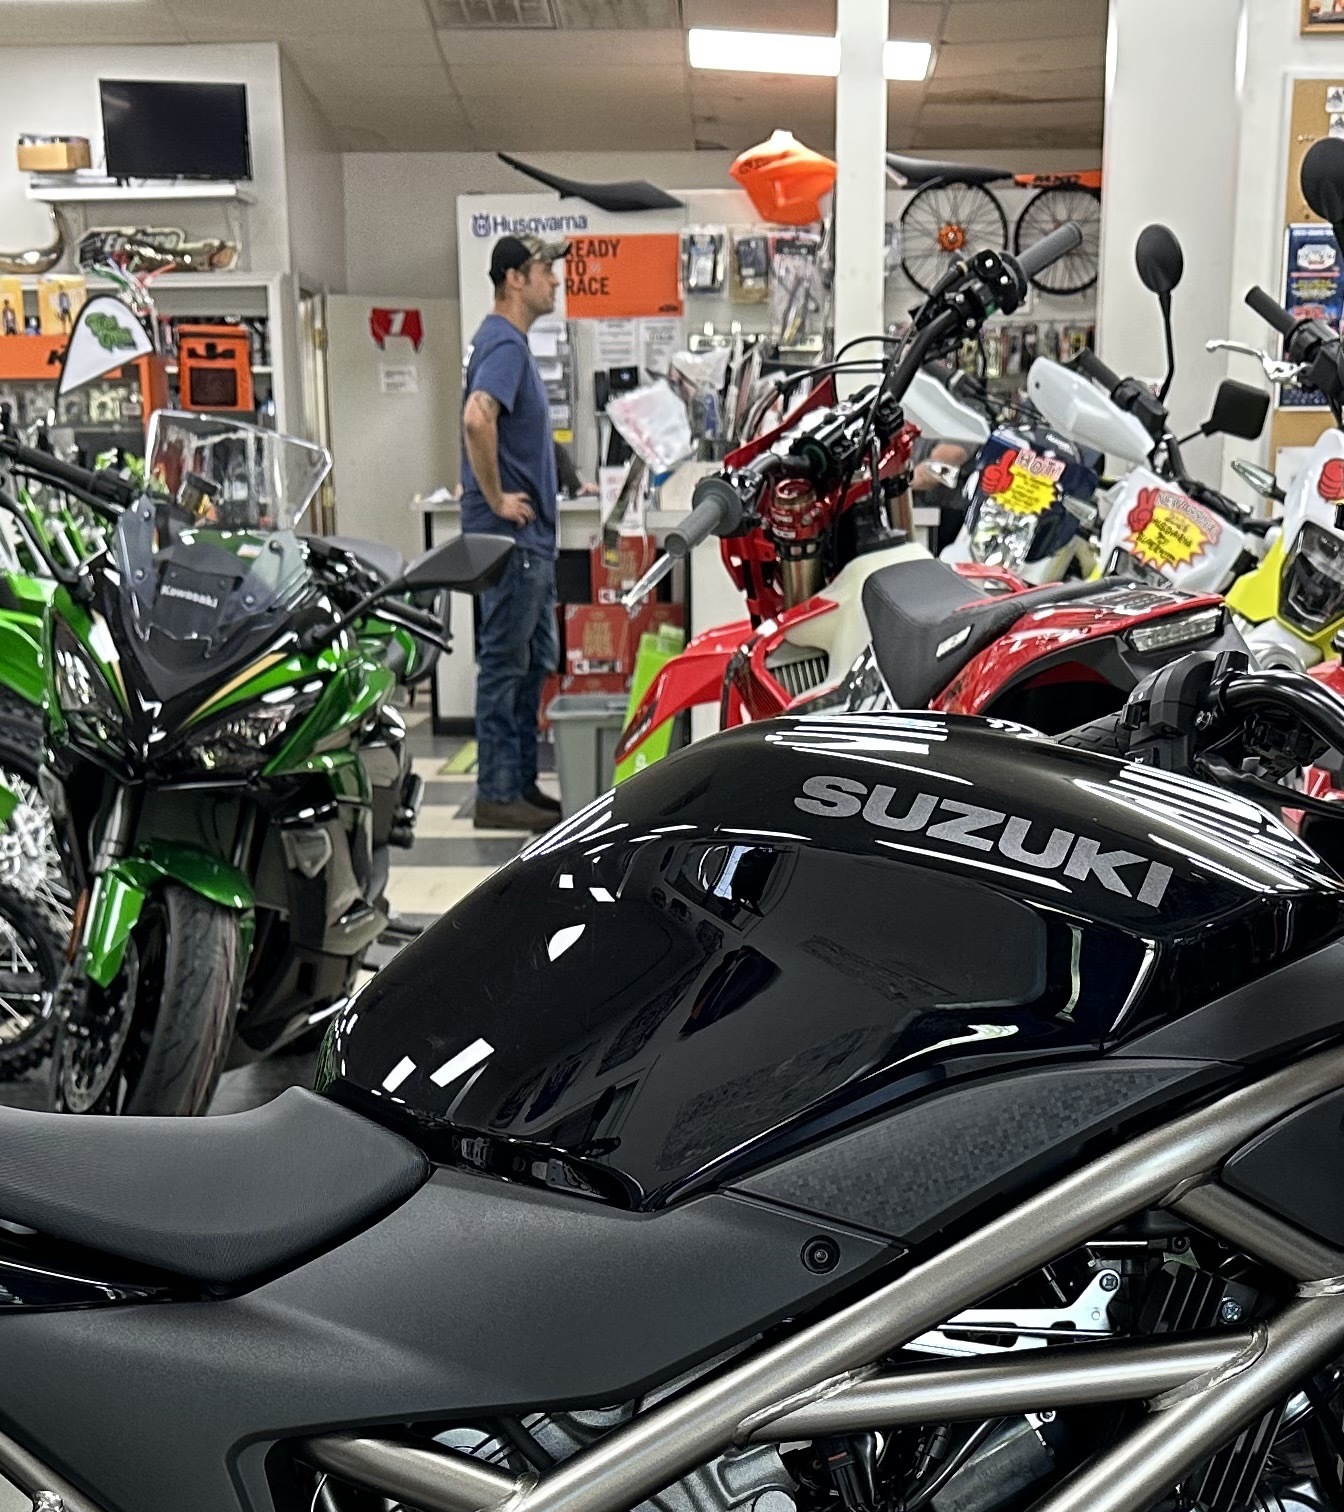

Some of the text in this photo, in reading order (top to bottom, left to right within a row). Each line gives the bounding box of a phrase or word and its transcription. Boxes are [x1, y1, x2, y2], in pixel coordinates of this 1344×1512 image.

[492, 213, 588, 235] Husqvarna
[566, 259, 587, 276] TO
[566, 277, 610, 296] RACE
[159, 583, 218, 608] Kawasaki
[794, 775, 1174, 908] SUZUKI
